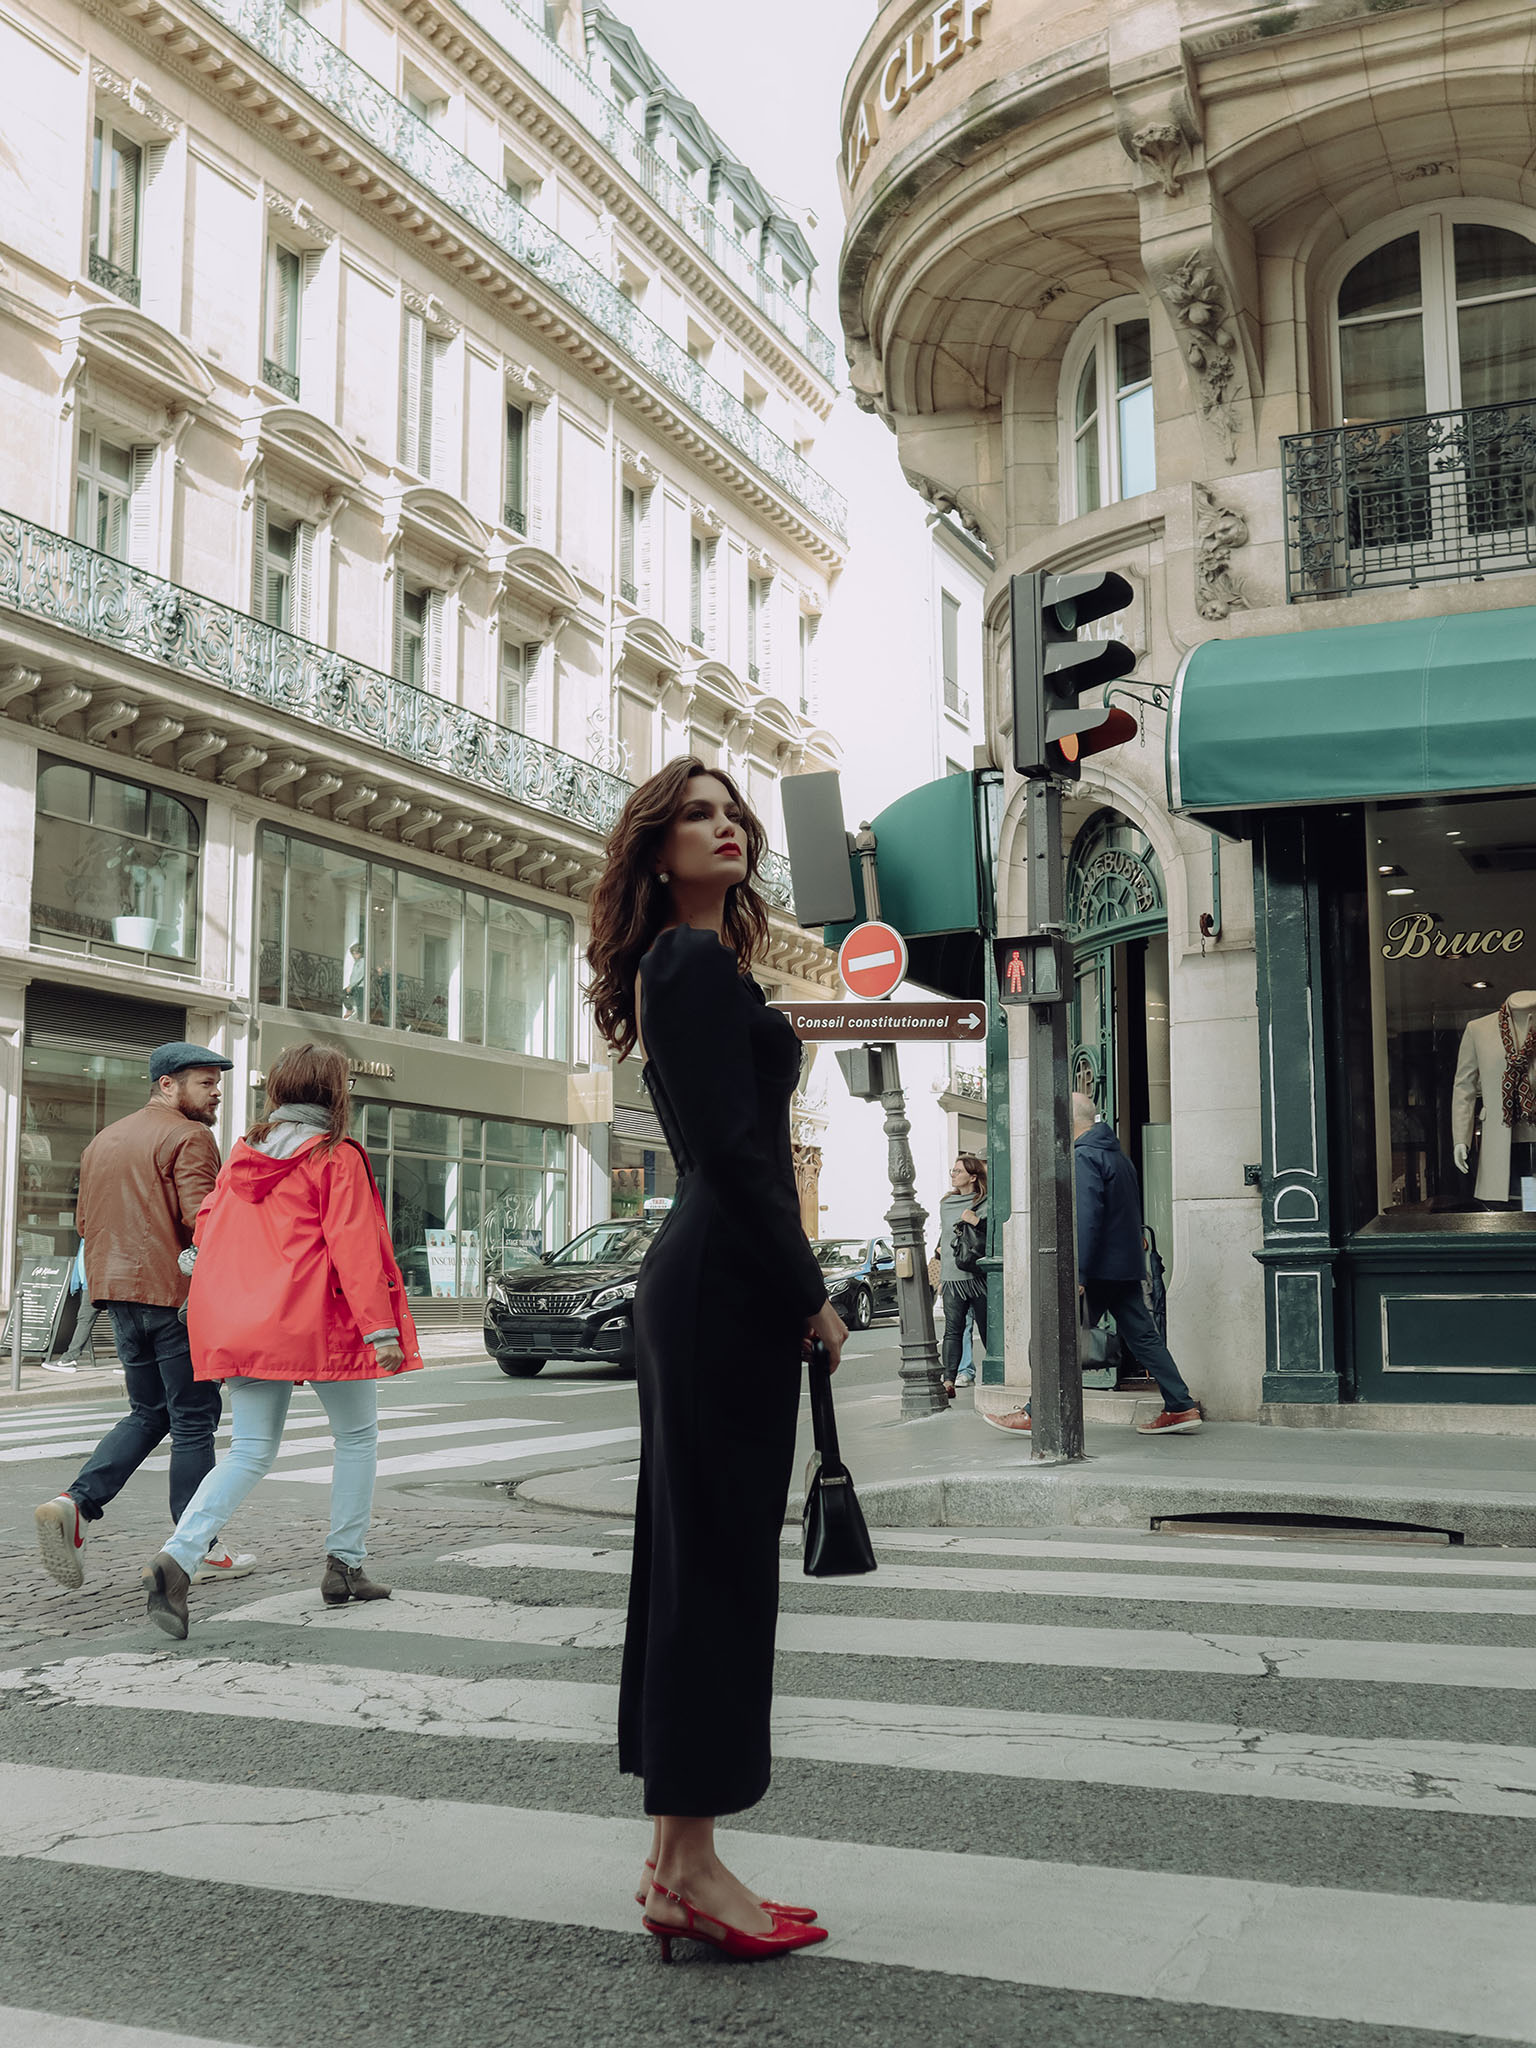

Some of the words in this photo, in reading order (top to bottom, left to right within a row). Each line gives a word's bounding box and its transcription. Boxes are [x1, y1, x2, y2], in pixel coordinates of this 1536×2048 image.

[1382, 912, 1525, 960] Bruce
[797, 1015, 845, 1028] Conseil
[848, 1015, 949, 1028] constitutionnel
